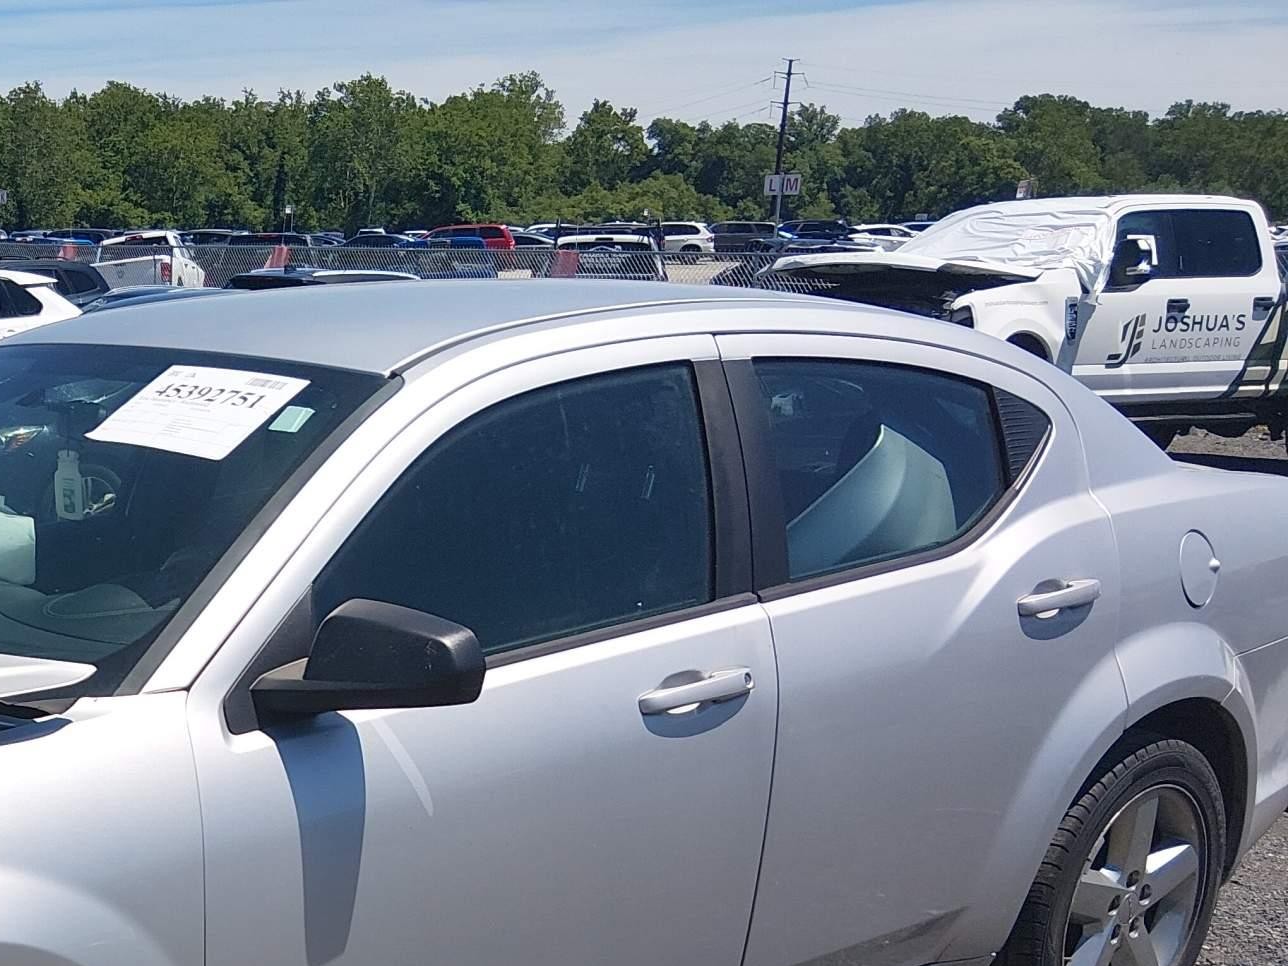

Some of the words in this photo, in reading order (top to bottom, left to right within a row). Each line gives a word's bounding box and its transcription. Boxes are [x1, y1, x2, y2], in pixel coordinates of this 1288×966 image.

[768, 178, 777, 192] L
[785, 177, 799, 192] M
[1152, 313, 1247, 333] JOSHUA'S
[1151, 336, 1241, 350] LANDSCAPING
[154, 383, 267, 409] 45392751
